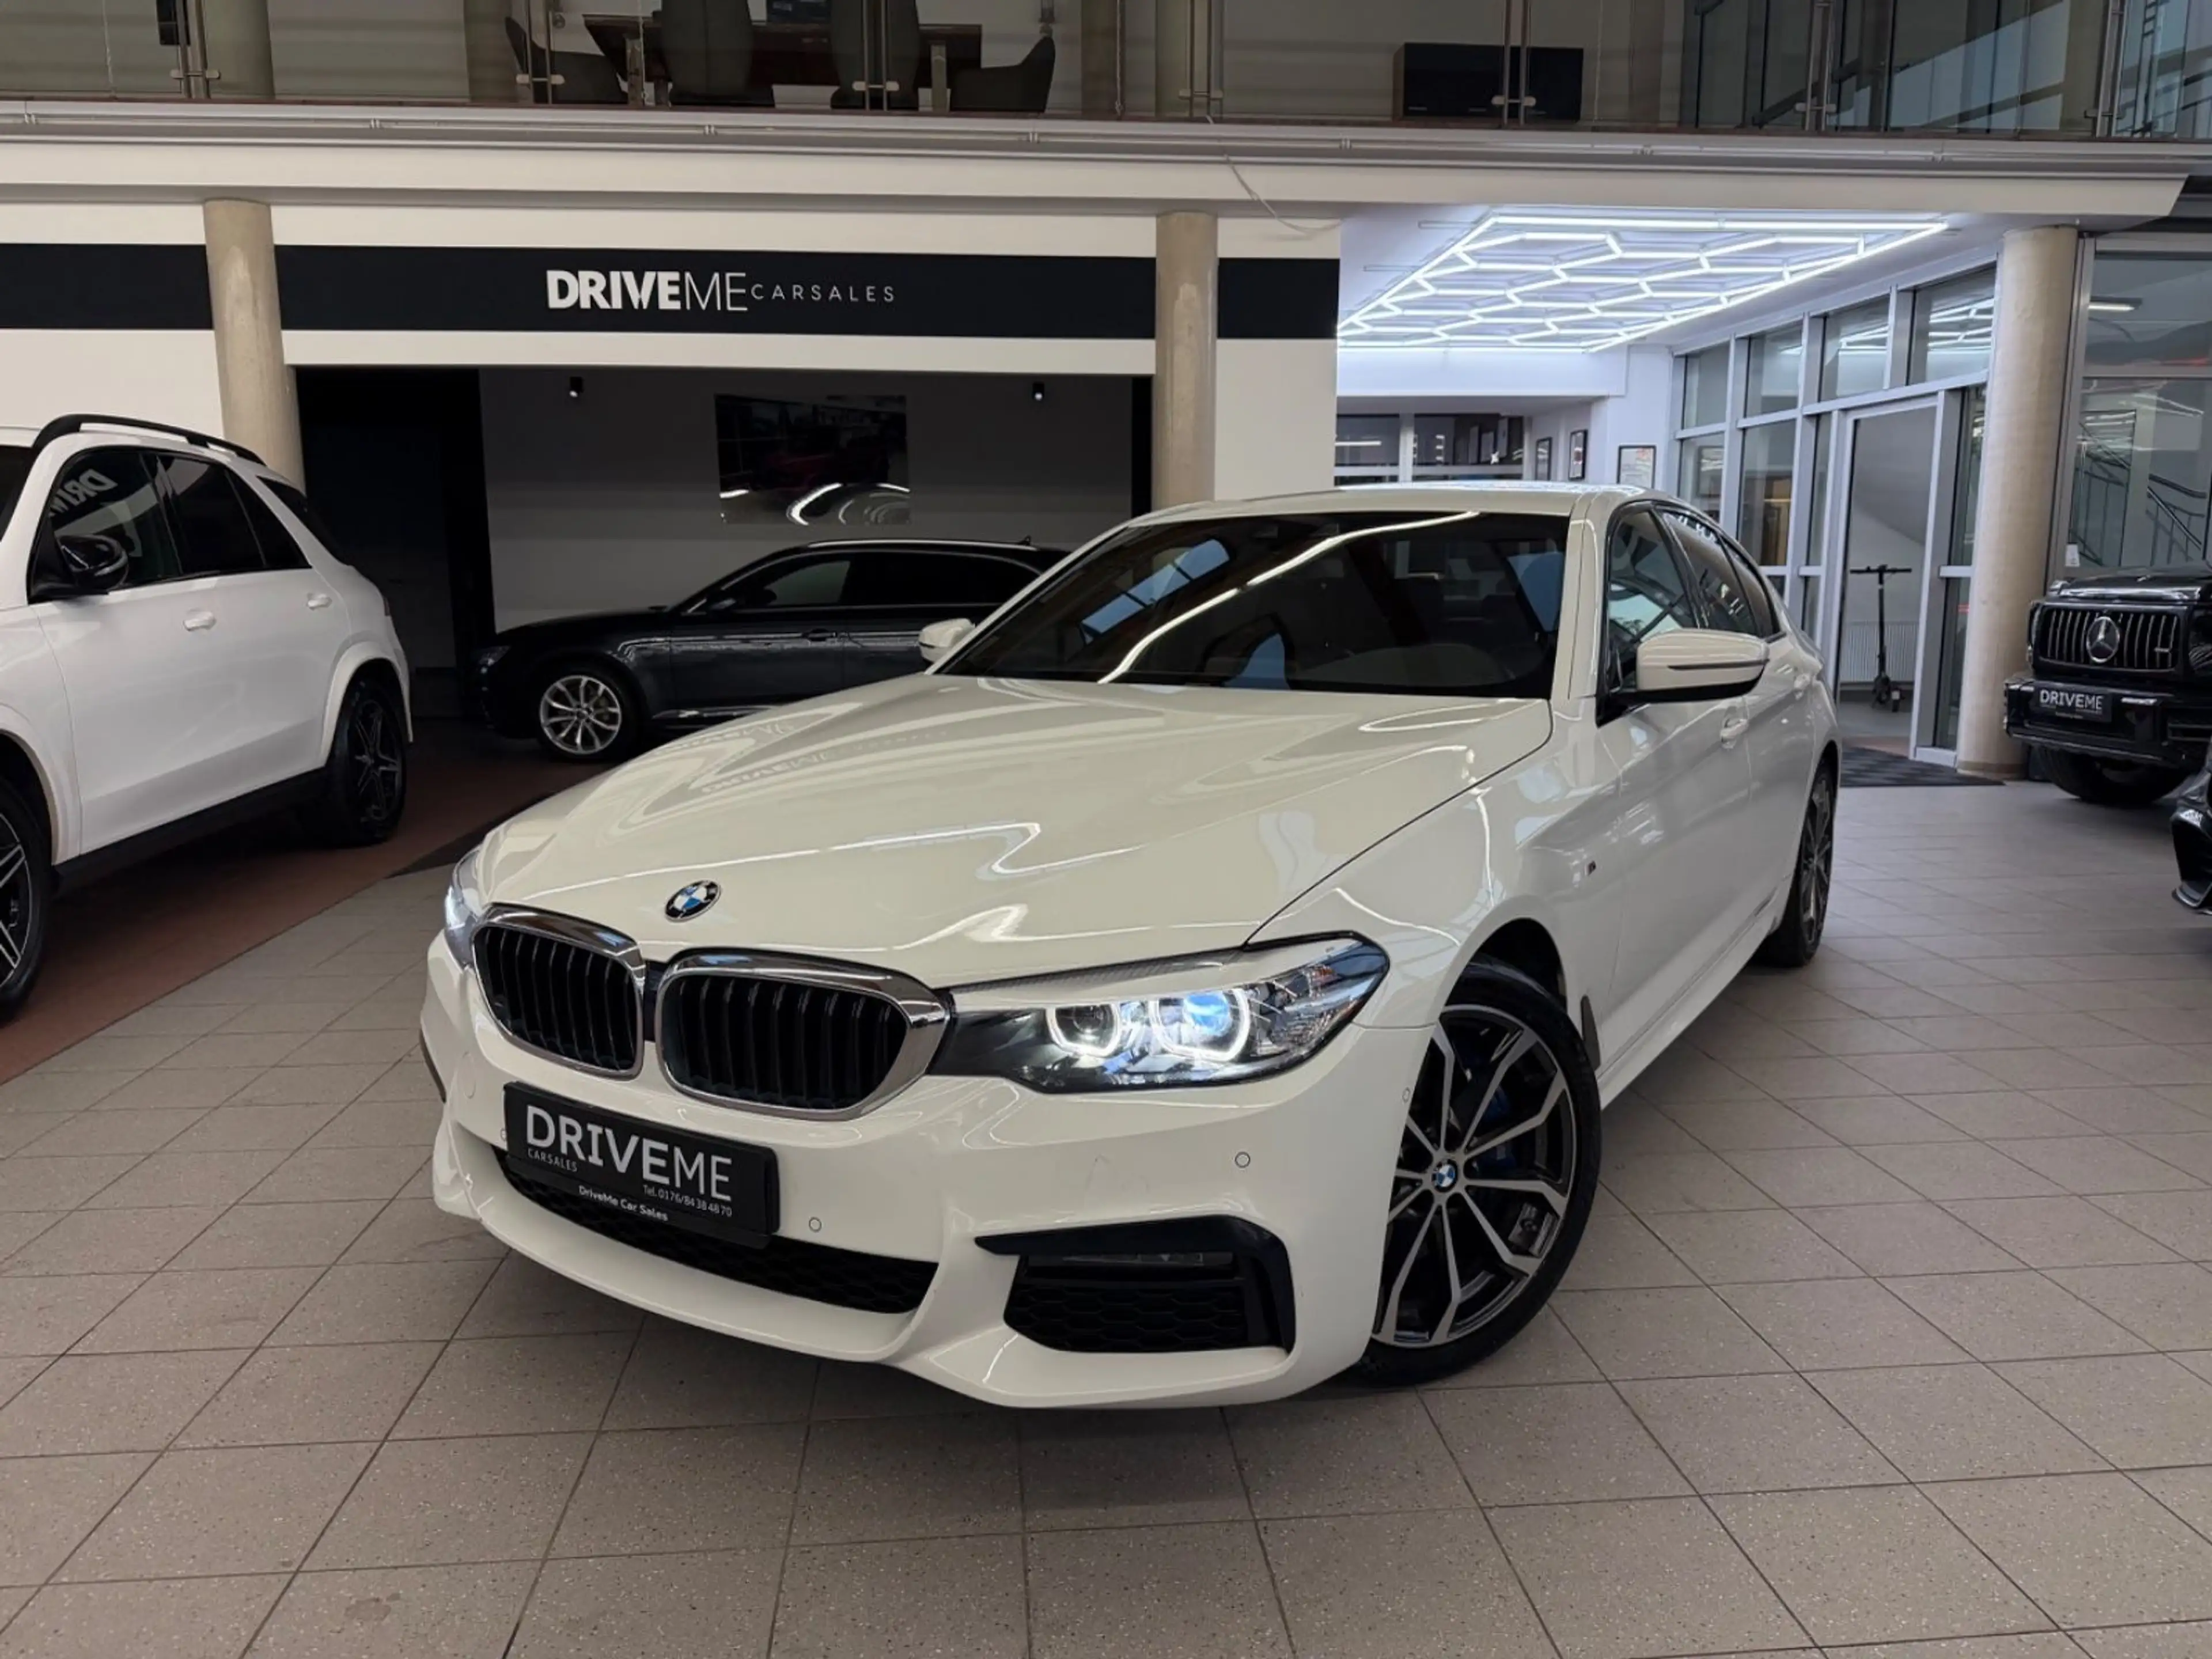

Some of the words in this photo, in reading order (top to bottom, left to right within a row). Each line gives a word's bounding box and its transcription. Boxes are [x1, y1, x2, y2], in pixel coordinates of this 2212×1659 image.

[546, 270, 748, 311] DRIVEME
[751, 283, 895, 302] CARSALES
[2040, 690, 2104, 710] DRIVEME
[527, 1104, 732, 1201] DRIVEME
[620, 1198, 638, 1212] Car
[639, 1203, 668, 1221] Sales
